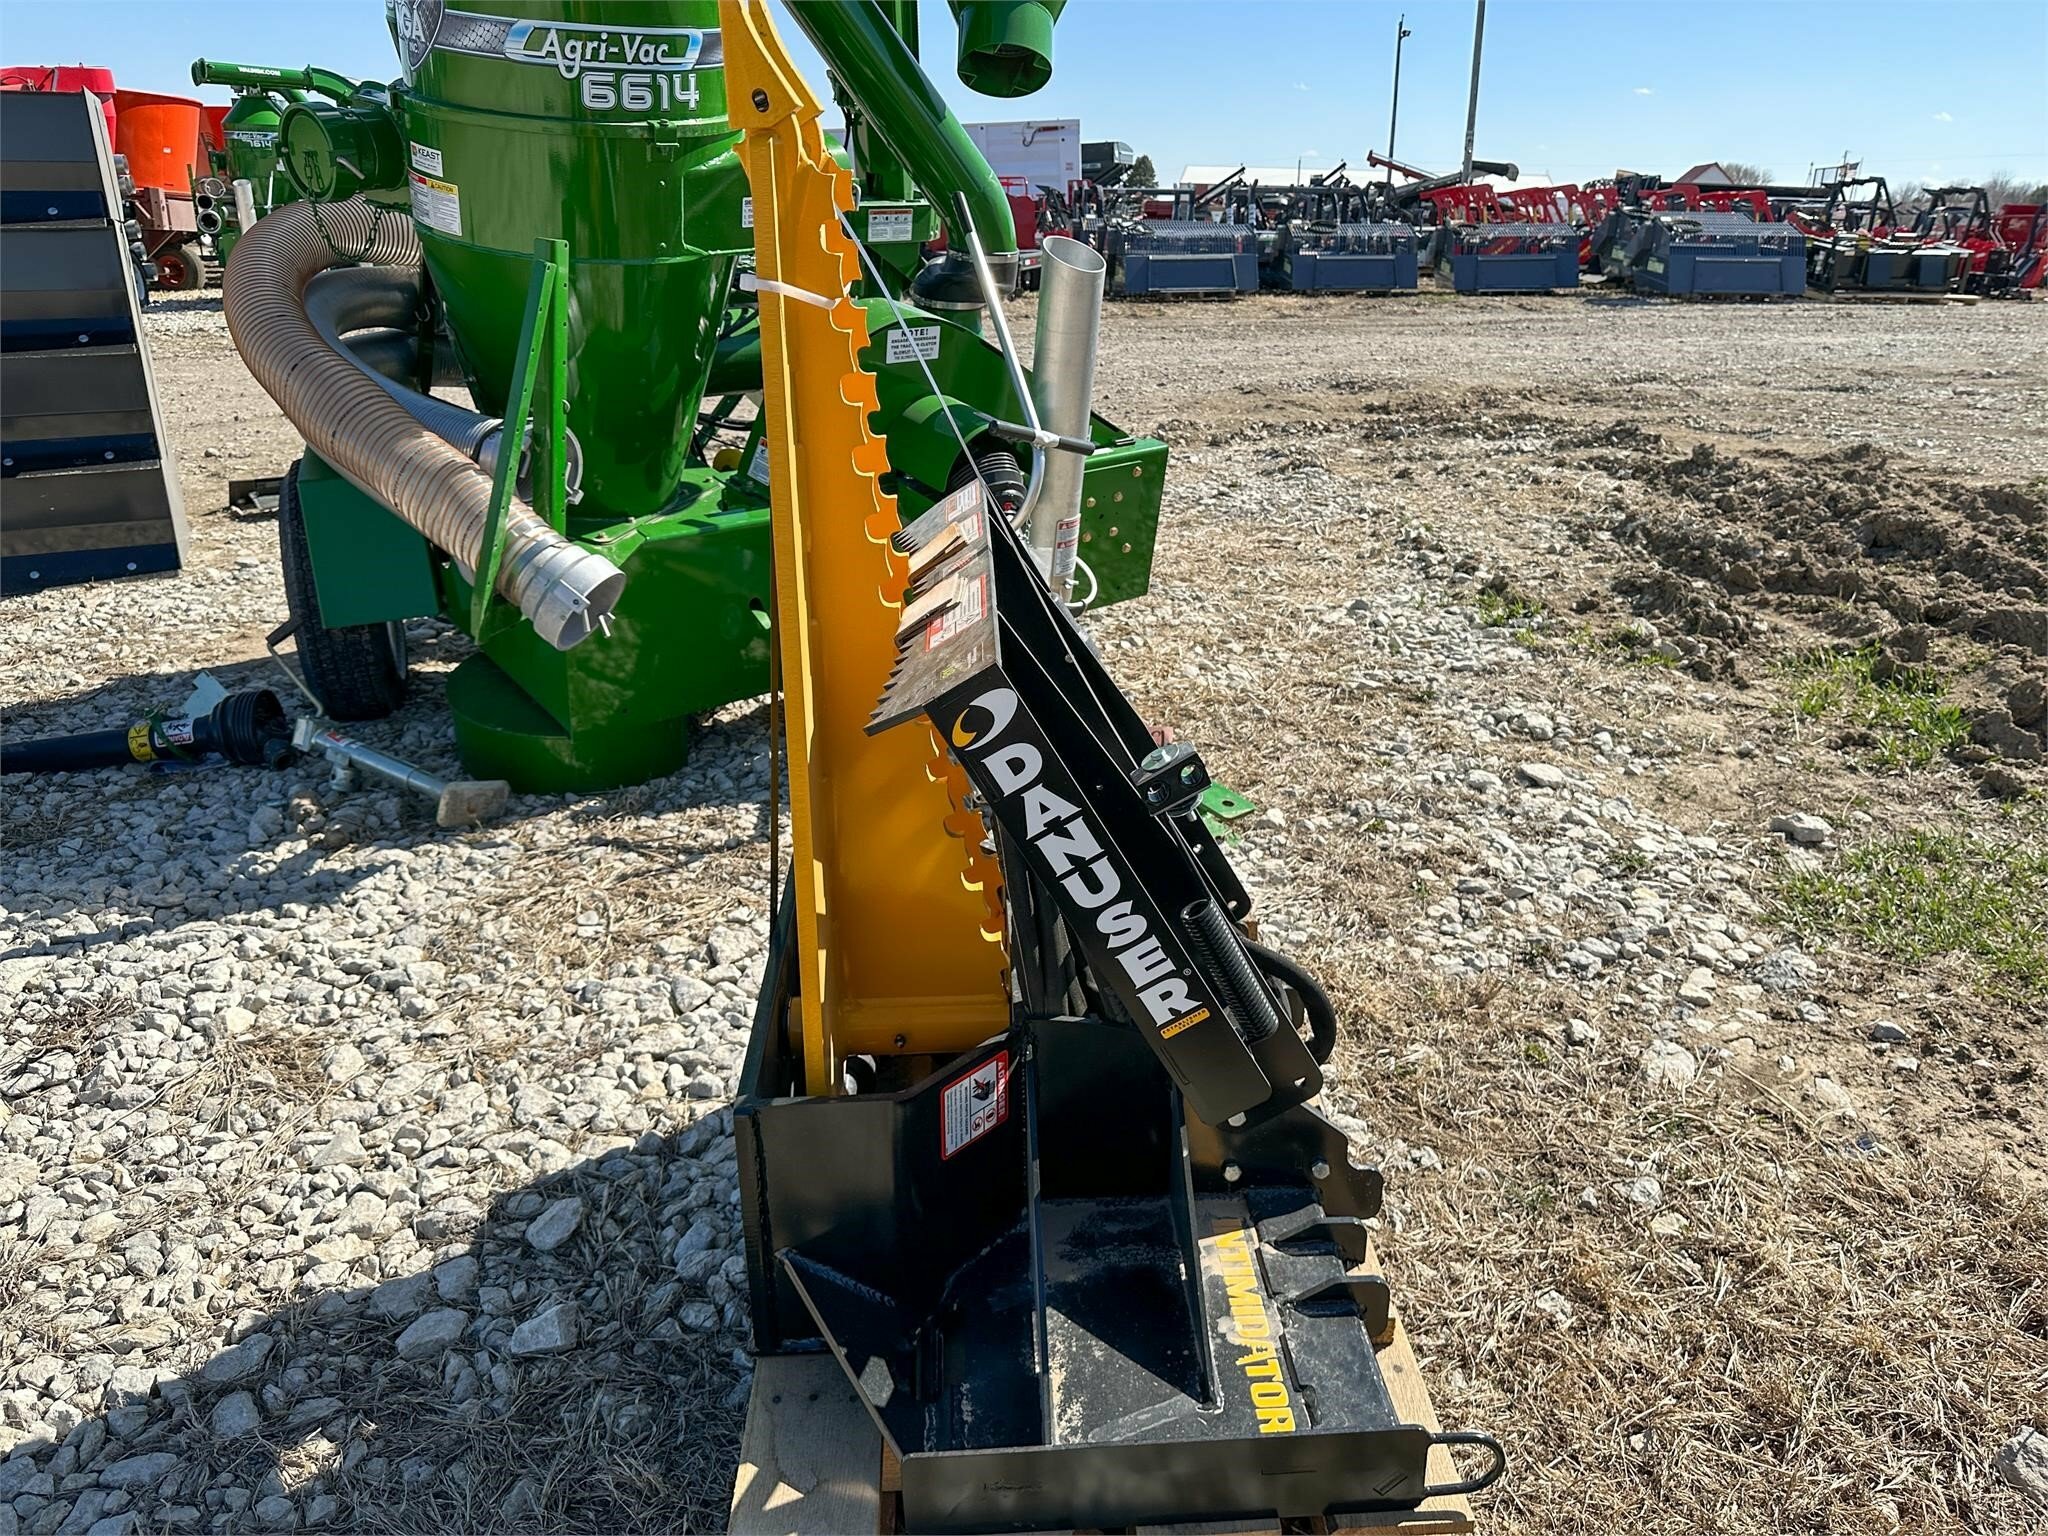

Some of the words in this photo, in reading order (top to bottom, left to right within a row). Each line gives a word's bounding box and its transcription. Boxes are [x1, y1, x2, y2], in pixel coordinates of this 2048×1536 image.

[540, 28, 669, 79] Agri-Vac
[580, 71, 701, 112] 6614
[418, 147, 440, 160] KEAST
[981, 743, 1203, 1027] DANUSER
[998, 1070, 1007, 1118] DANGER
